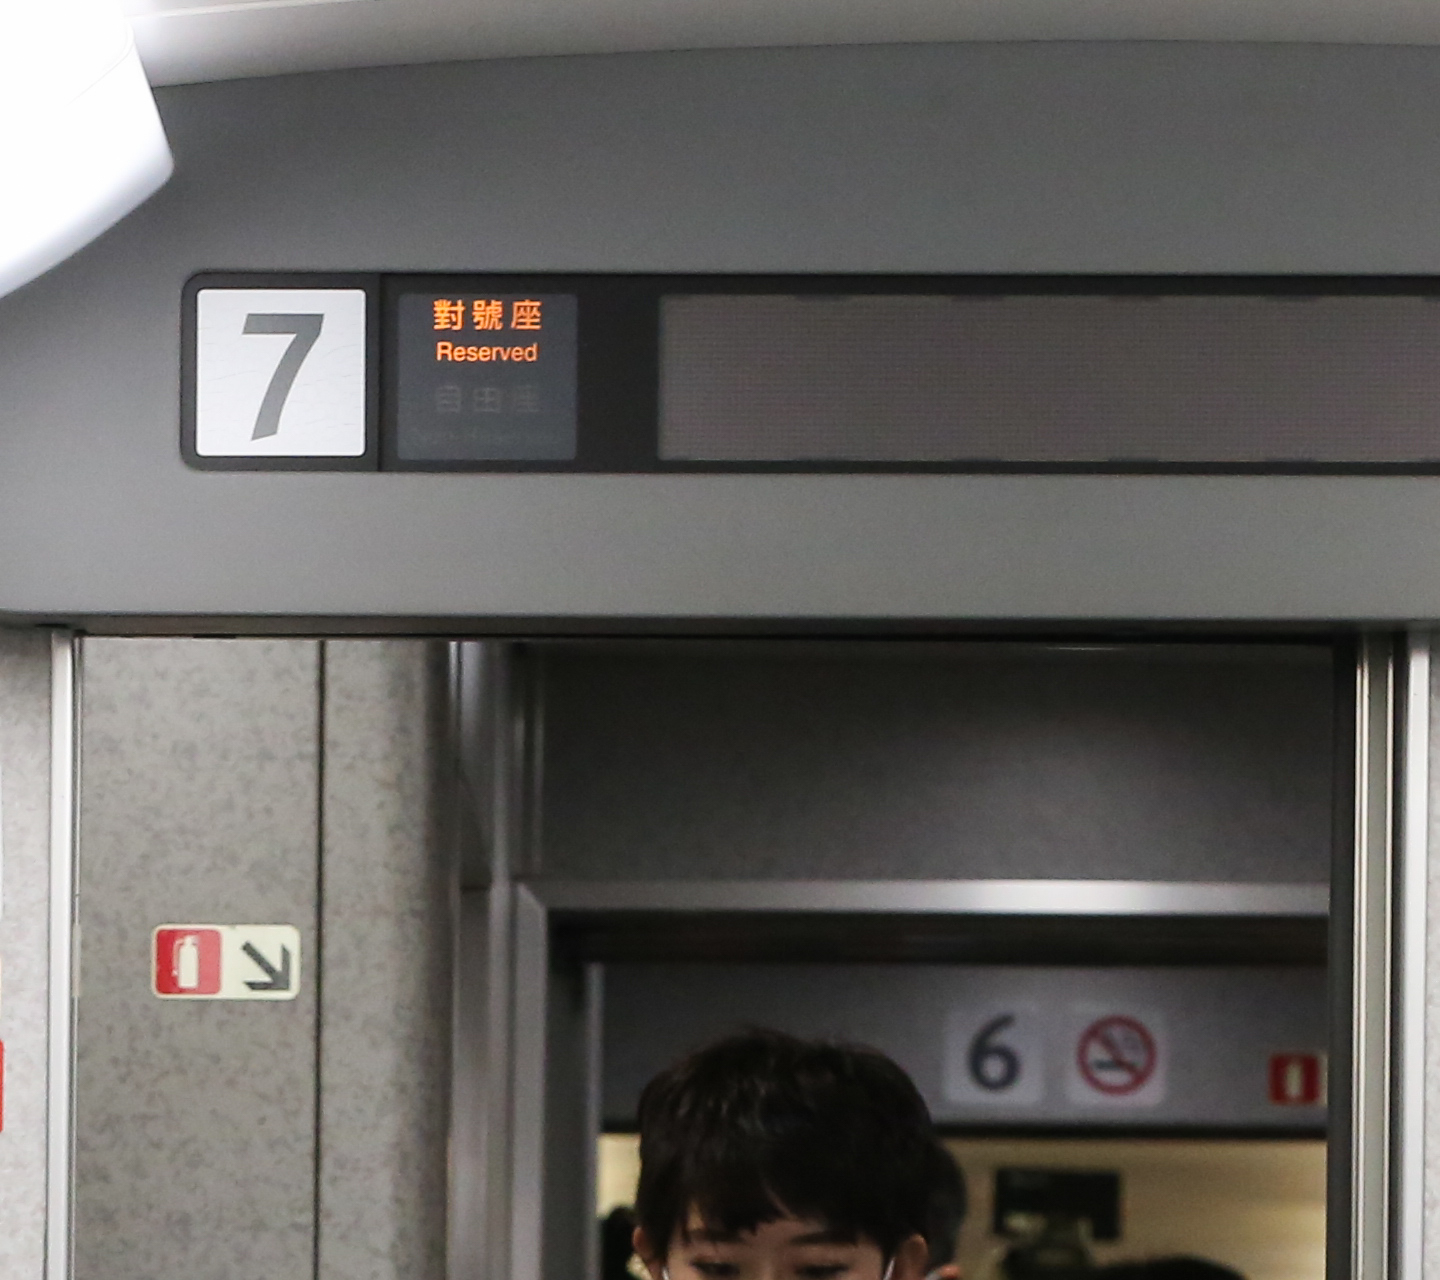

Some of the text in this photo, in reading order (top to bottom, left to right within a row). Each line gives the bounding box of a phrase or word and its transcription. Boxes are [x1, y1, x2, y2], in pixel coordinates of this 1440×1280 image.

[433, 299, 543, 332] 對號座
[242, 313, 325, 442] 7
[436, 342, 539, 363] Reserved
[968, 1013, 1020, 1092] 6
